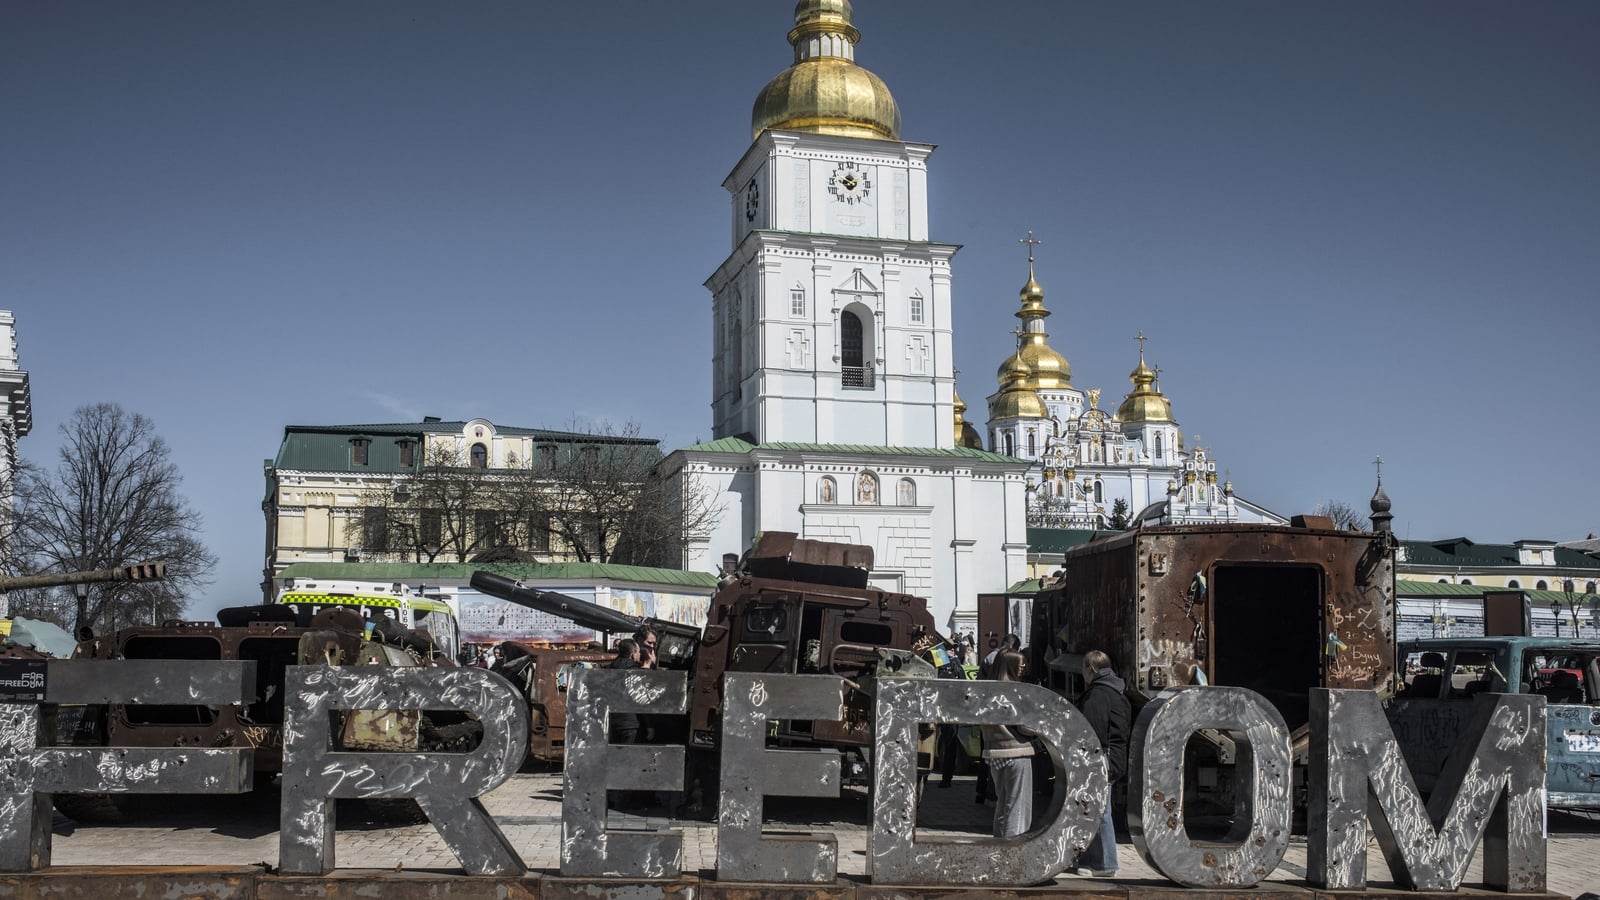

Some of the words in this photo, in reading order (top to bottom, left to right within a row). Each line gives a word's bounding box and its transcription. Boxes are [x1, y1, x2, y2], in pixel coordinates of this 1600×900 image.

[846, 161, 854, 169] XII
[827, 186, 837, 195] VIII
[0, 658, 1547, 892] FREEDOM
